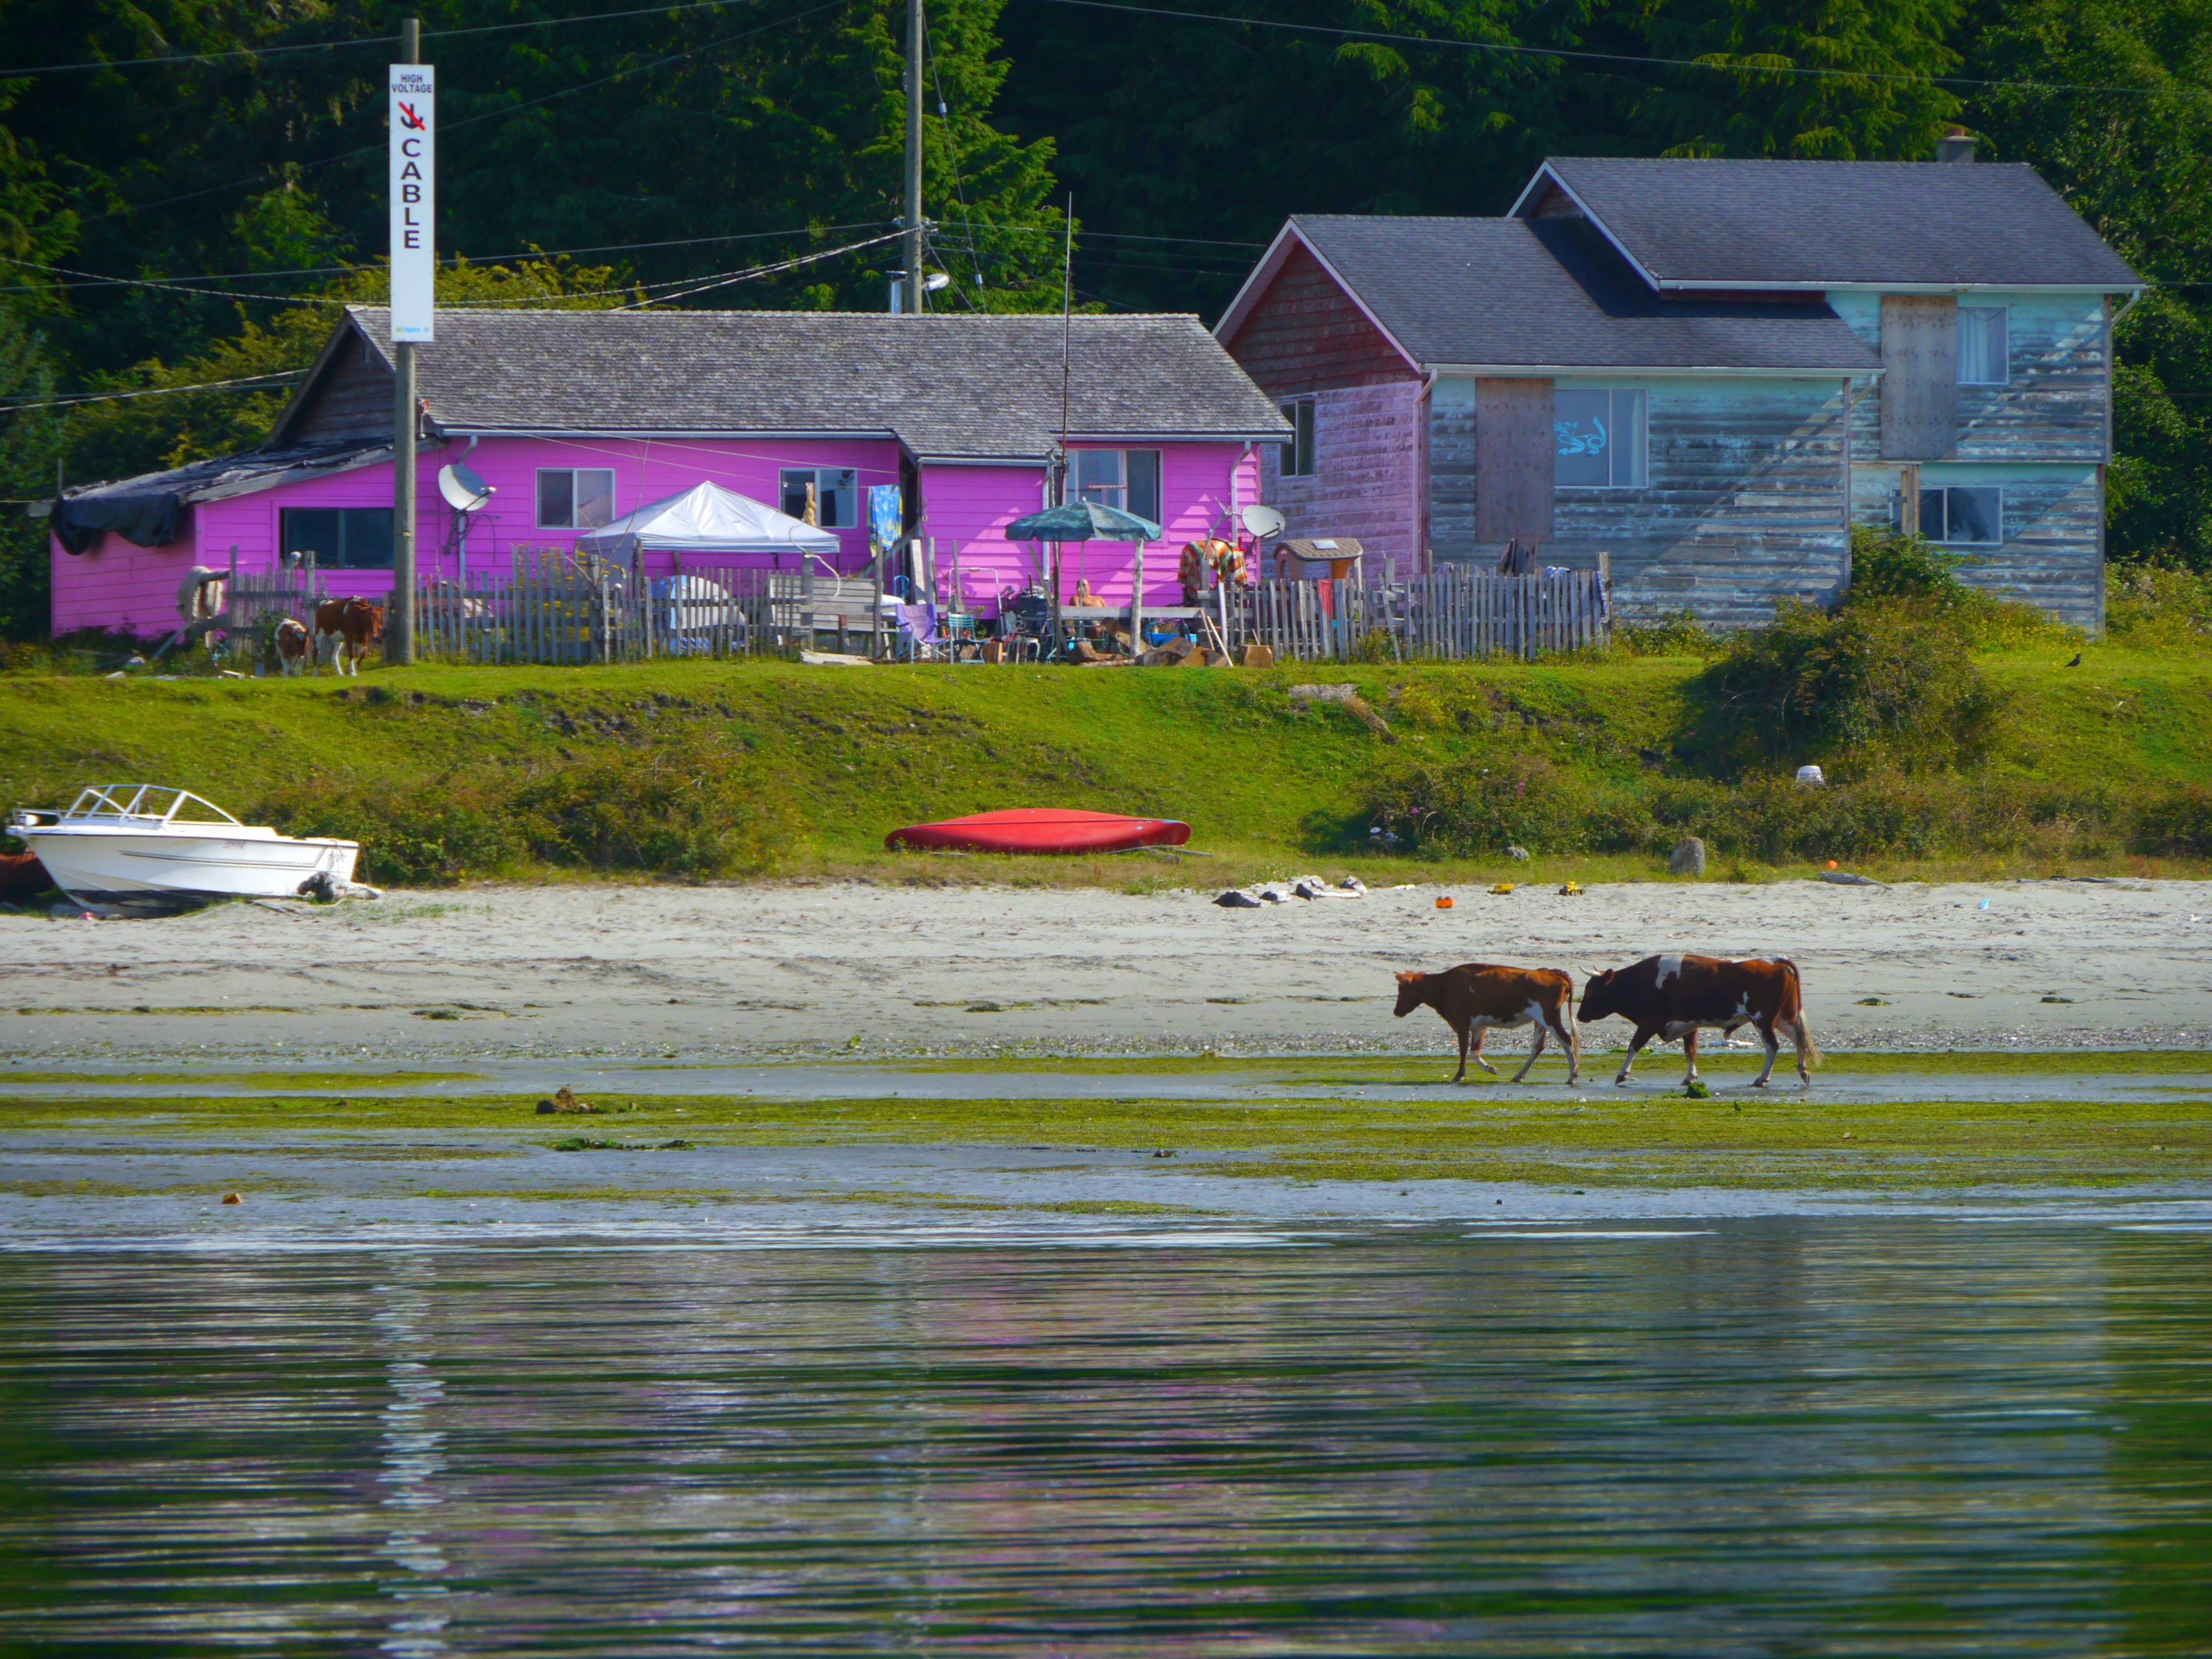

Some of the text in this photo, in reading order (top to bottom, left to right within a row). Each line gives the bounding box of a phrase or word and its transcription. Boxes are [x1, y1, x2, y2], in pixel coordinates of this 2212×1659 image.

[401, 74, 423, 83] HIGH
[392, 84, 432, 93] VOLTAGE
[401, 138, 422, 249] CABLE
